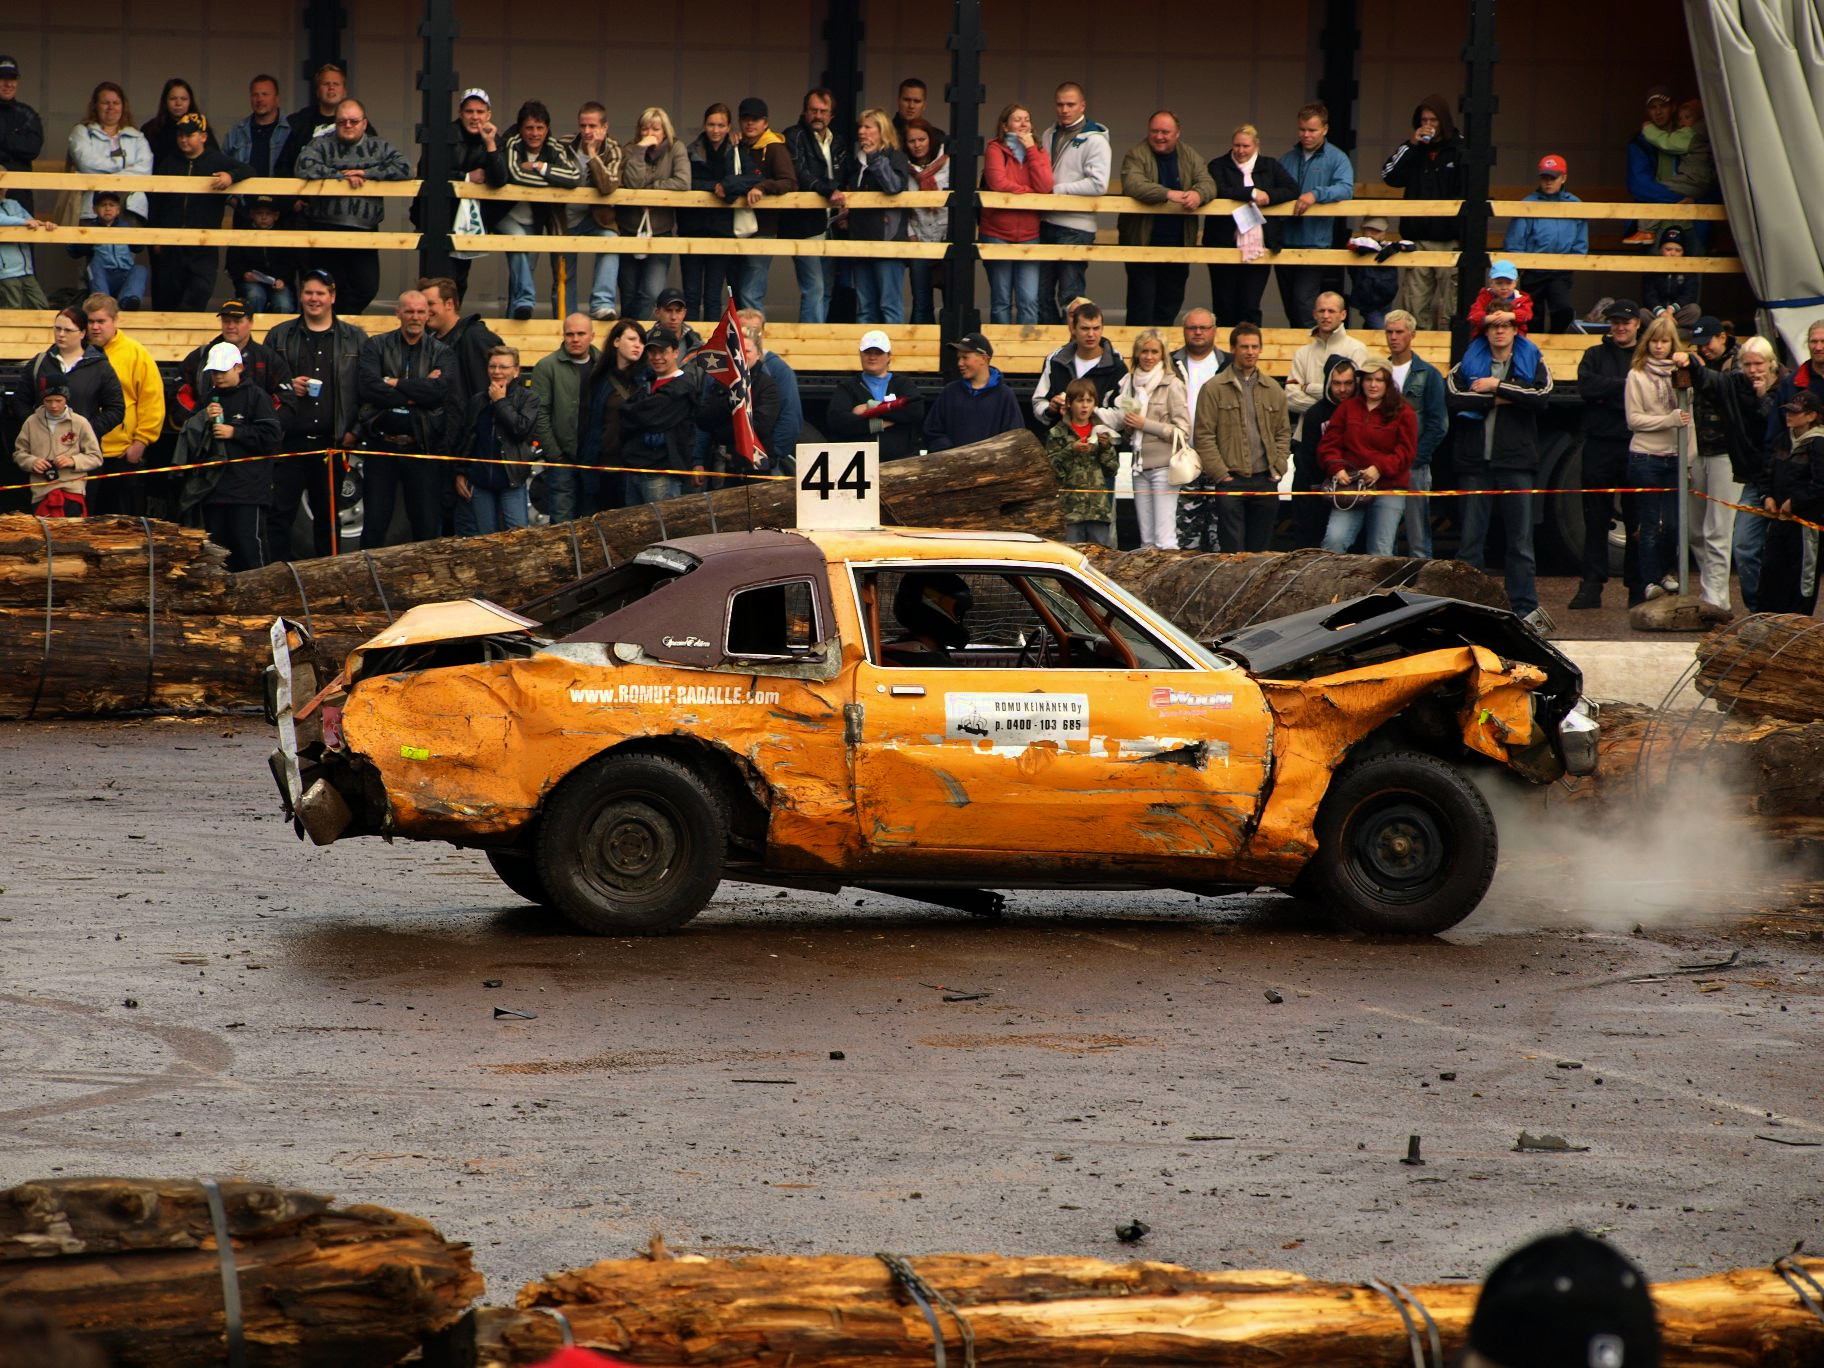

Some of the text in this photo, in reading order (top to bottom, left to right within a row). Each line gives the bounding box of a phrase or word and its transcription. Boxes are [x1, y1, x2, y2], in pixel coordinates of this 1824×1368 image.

[801, 450, 871, 500] 44
[570, 684, 780, 705] www.ROMUT-RADALLE.com
[995, 701, 1021, 712] ROMU
[995, 720, 1004, 730] p.
[1063, 719, 1081, 730] 685
